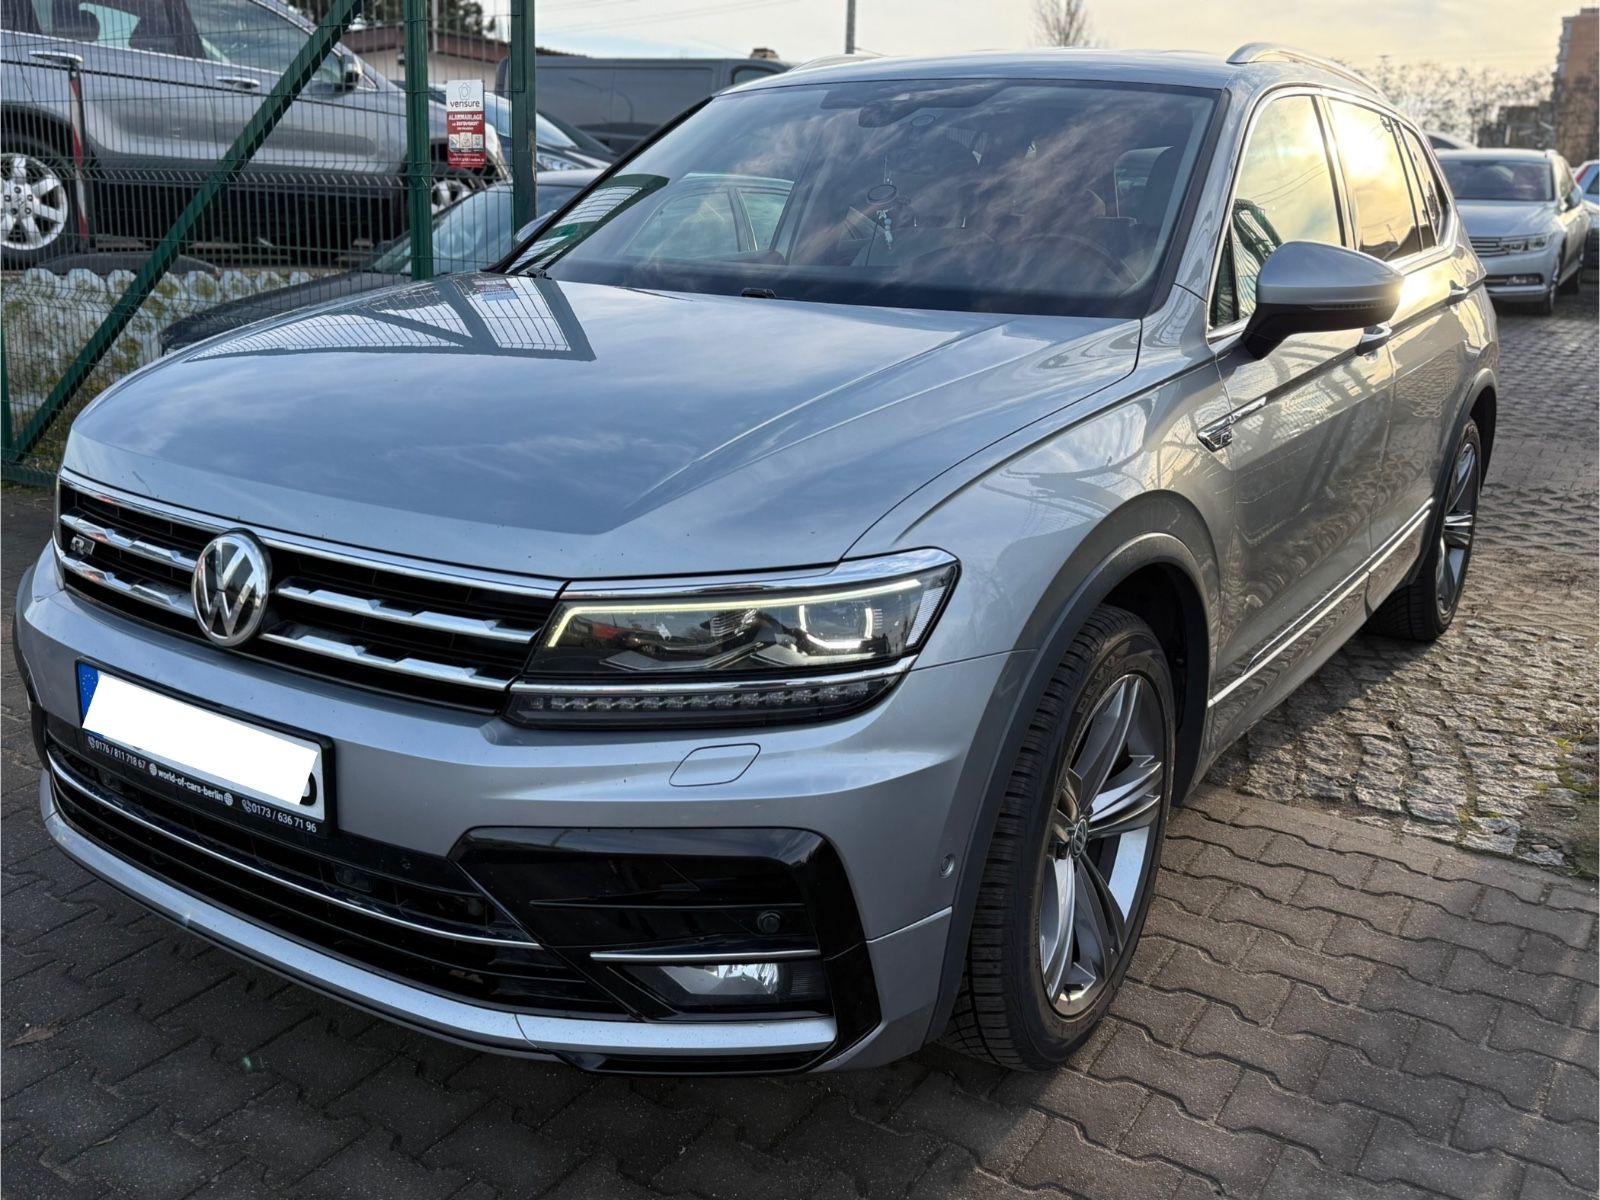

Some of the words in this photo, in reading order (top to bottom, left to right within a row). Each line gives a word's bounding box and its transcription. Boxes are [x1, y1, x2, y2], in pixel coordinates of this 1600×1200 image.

[450, 100, 480, 108] verisure
[95, 740, 109, 754] 0176
[114, 748, 125, 761] 811
[138, 759, 146, 769] 67
[158, 769, 224, 802] world-of-cars-berlin
[251, 803, 271, 818] 0173
[277, 812, 293, 825] 636
[294, 816, 304, 829] 71
[305, 821, 317, 833] 96
